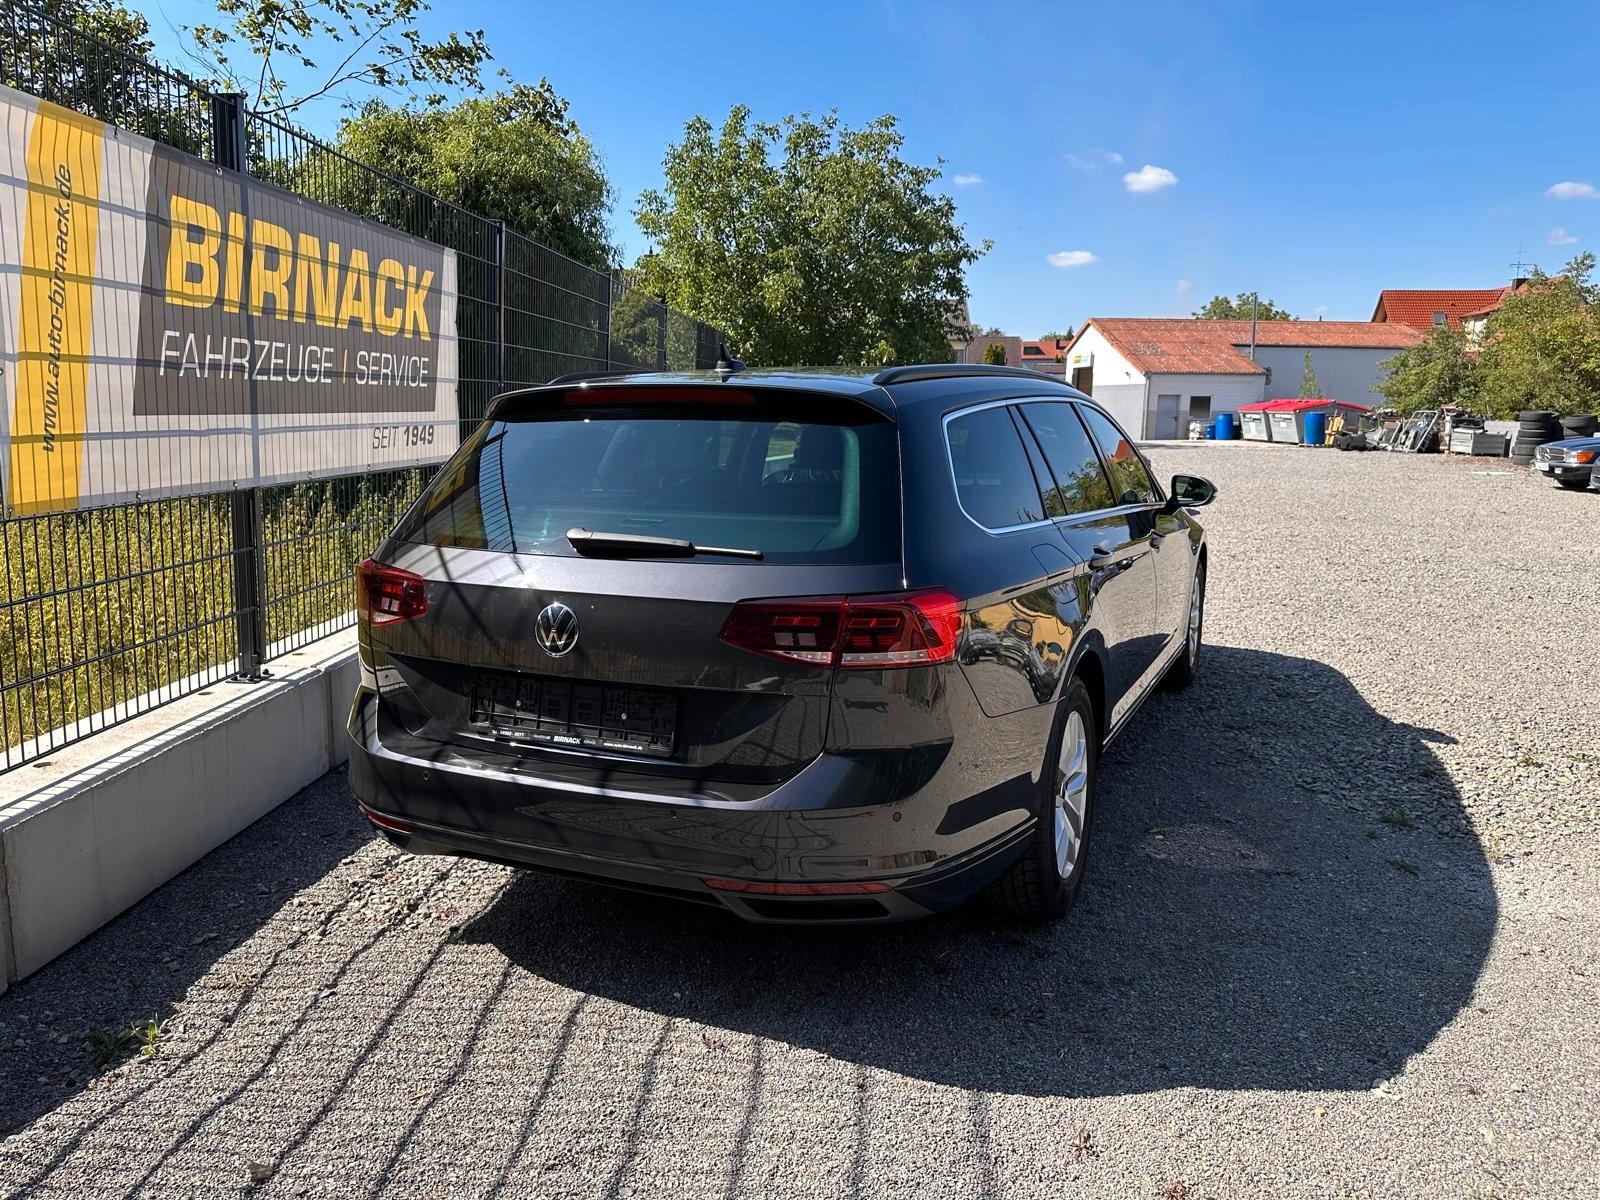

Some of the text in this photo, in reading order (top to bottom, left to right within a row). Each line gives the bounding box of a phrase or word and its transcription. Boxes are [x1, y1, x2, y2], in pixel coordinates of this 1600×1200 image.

[165, 194, 435, 342] BIRNACK
[43, 163, 71, 453] www.auto-birnack.de
[159, 329, 430, 388] FAHRZEUGE SERVICE
[372, 424, 435, 449] SEIT 1949
[553, 735, 582, 745] BIRNACK
